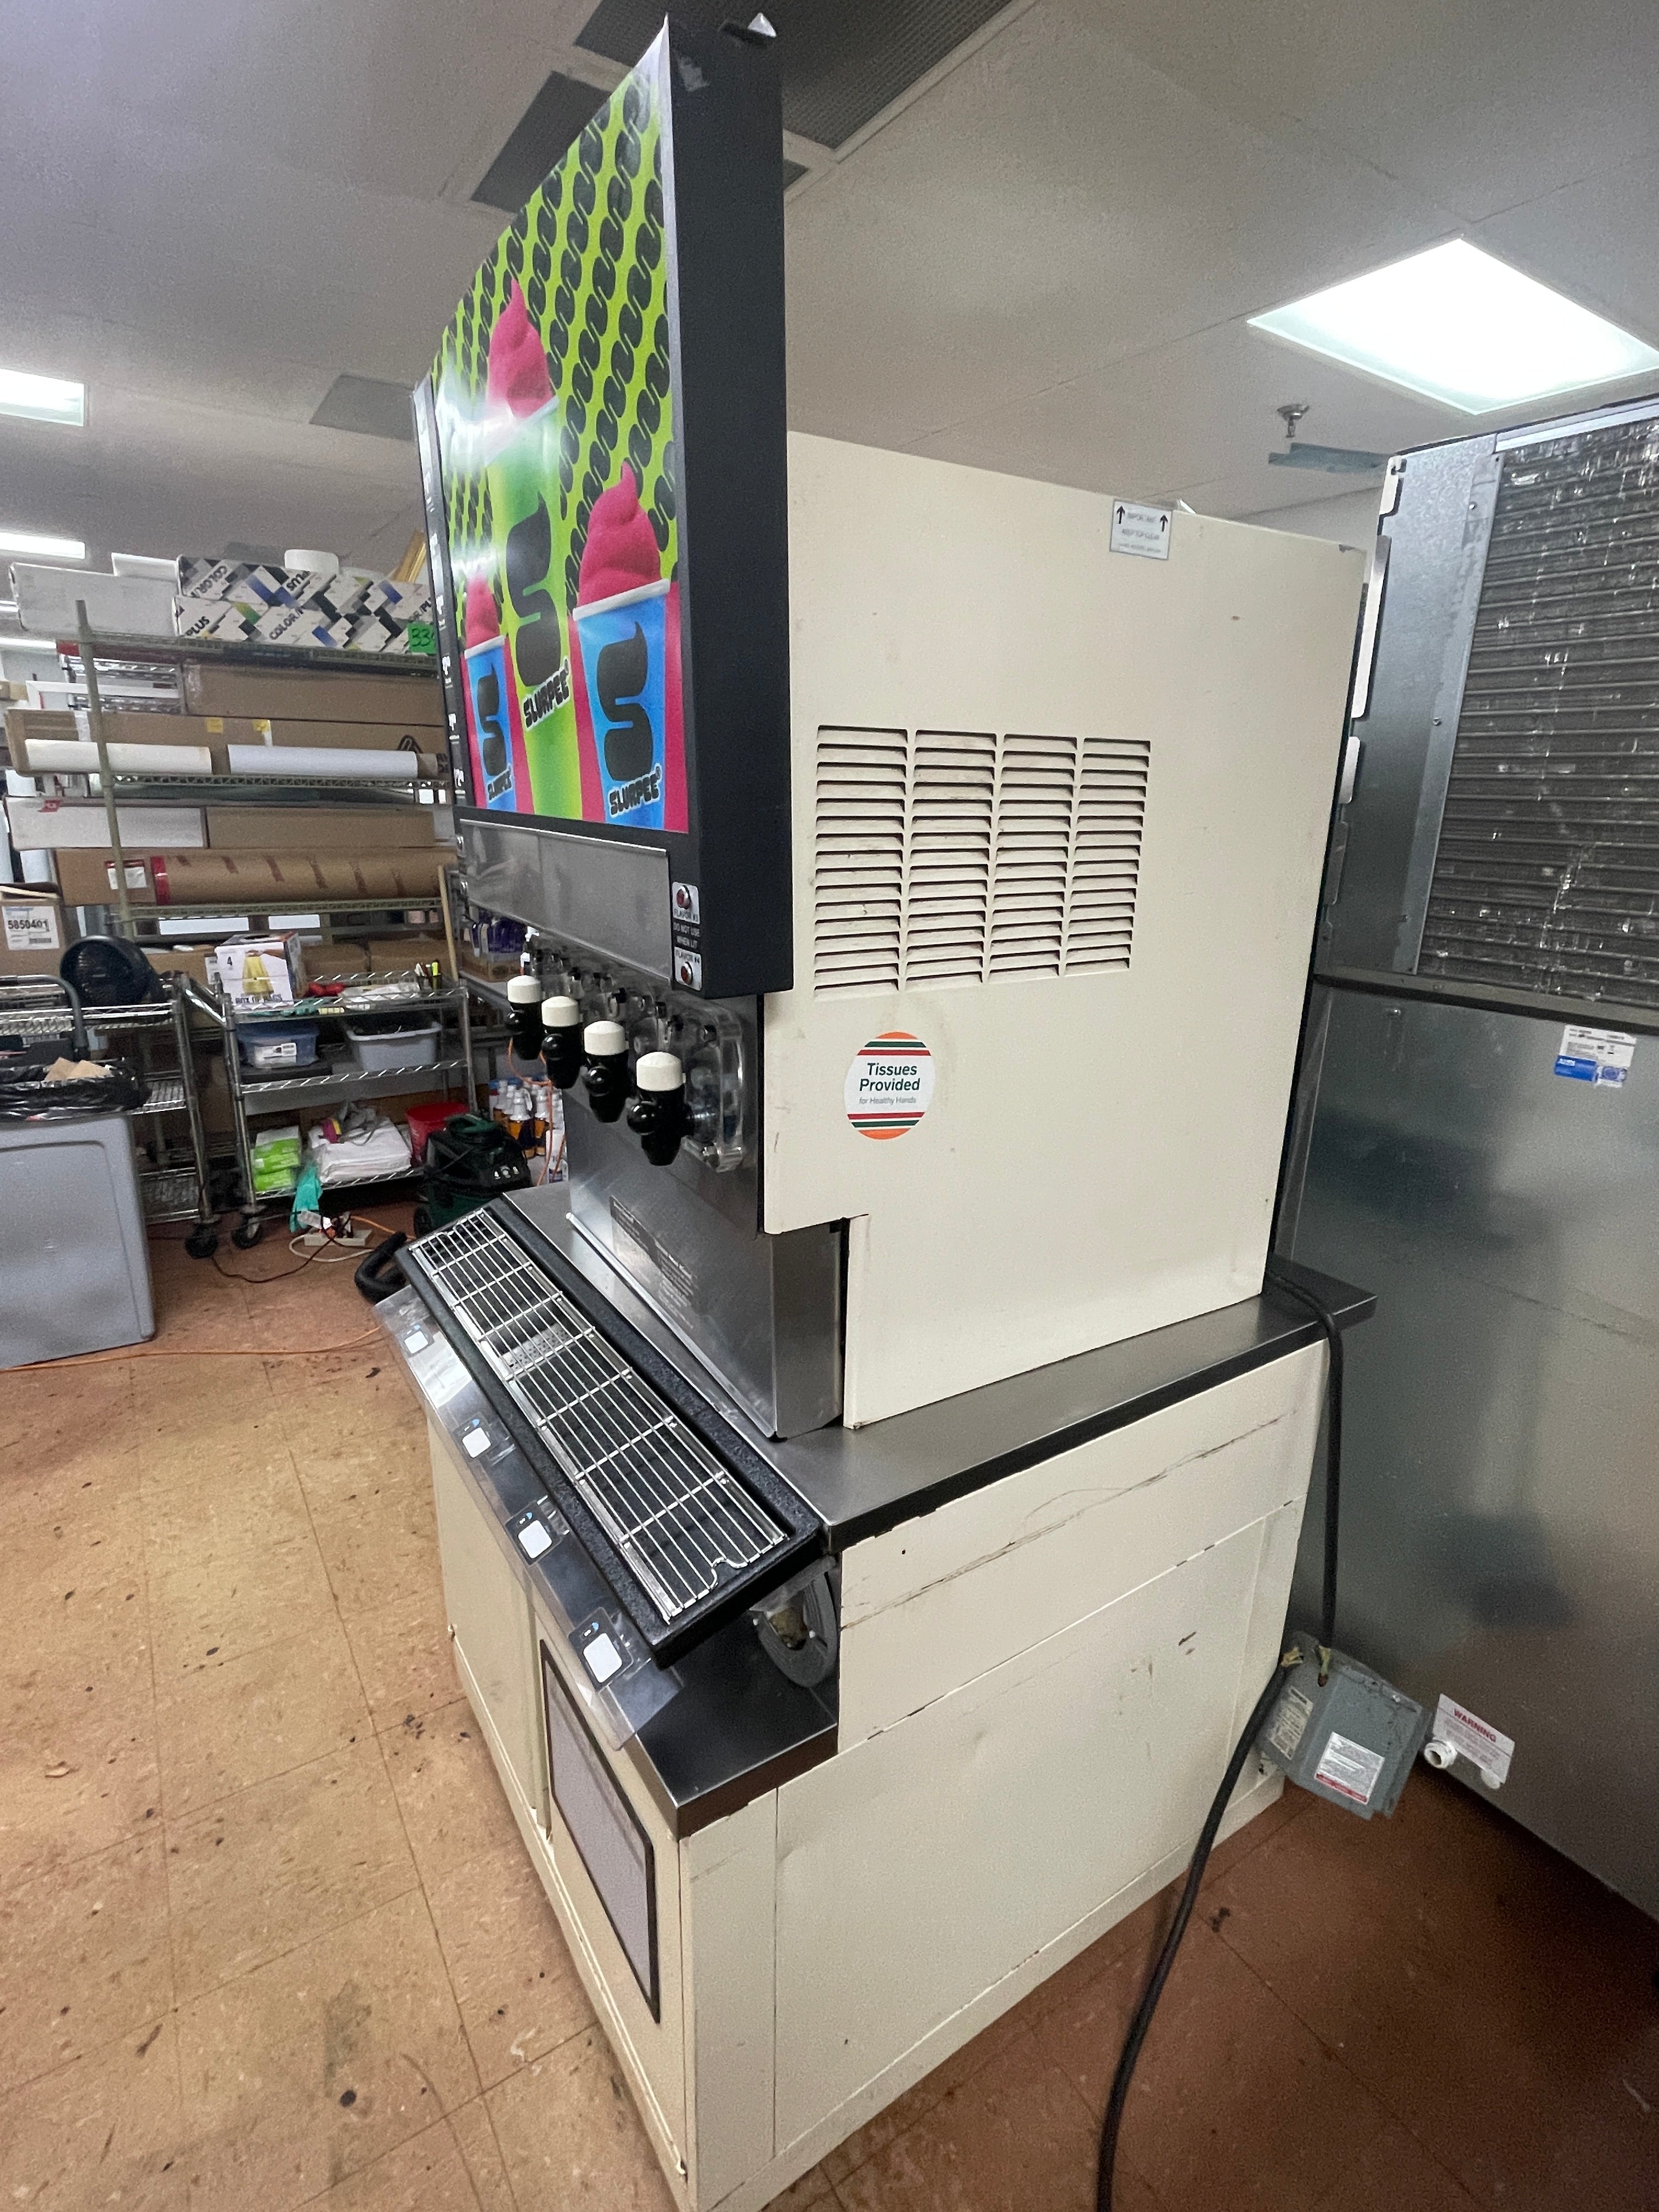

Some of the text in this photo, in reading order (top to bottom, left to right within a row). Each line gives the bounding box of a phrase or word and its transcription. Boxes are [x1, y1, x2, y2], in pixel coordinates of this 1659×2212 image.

[867, 1063, 917, 1076] Tissues
[859, 1078, 921, 1092] Provided
[870, 1097, 895, 1105] Healthy
[1454, 1708, 1497, 1742] WARNING
